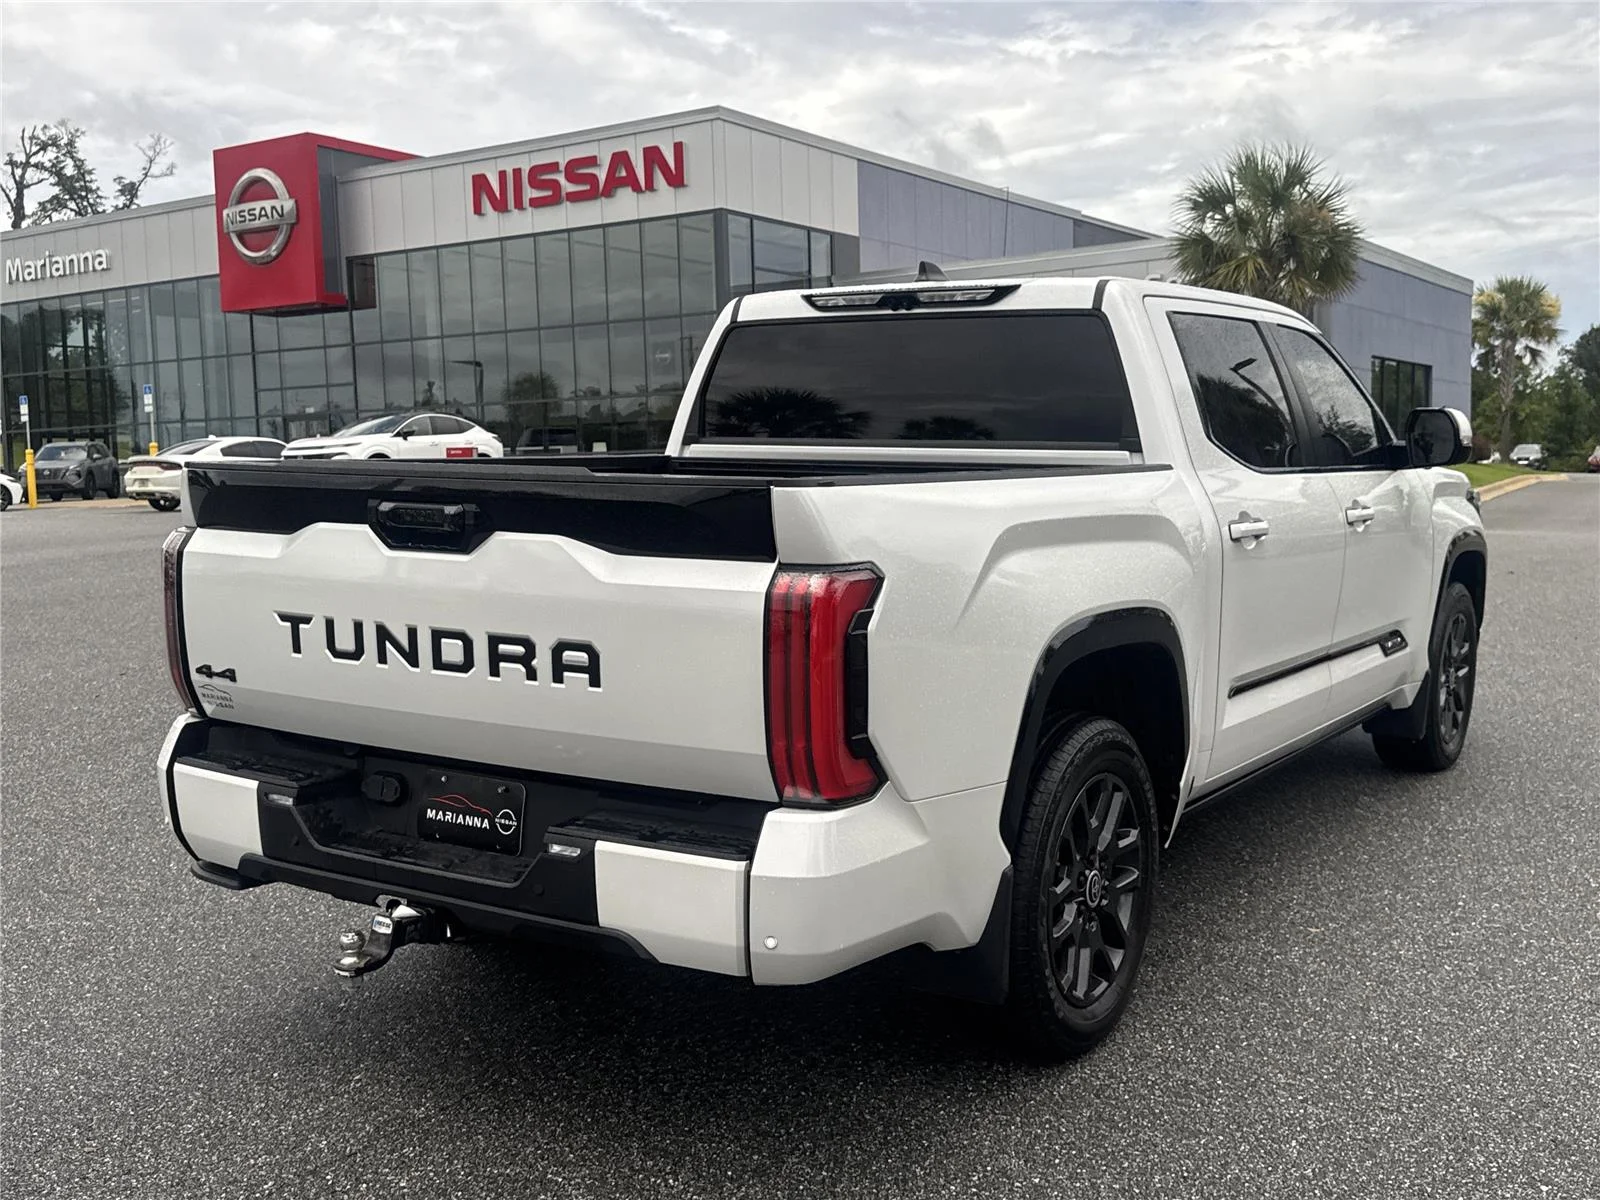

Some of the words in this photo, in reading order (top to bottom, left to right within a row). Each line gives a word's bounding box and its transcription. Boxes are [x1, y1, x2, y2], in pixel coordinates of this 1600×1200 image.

[472, 141, 687, 215] NISSAN
[227, 205, 284, 226] NISSAN
[5, 248, 108, 283] Marianna
[273, 610, 603, 692] TUNDRA
[427, 808, 490, 830] MARIANNA
[495, 818, 517, 826] NISSAN
